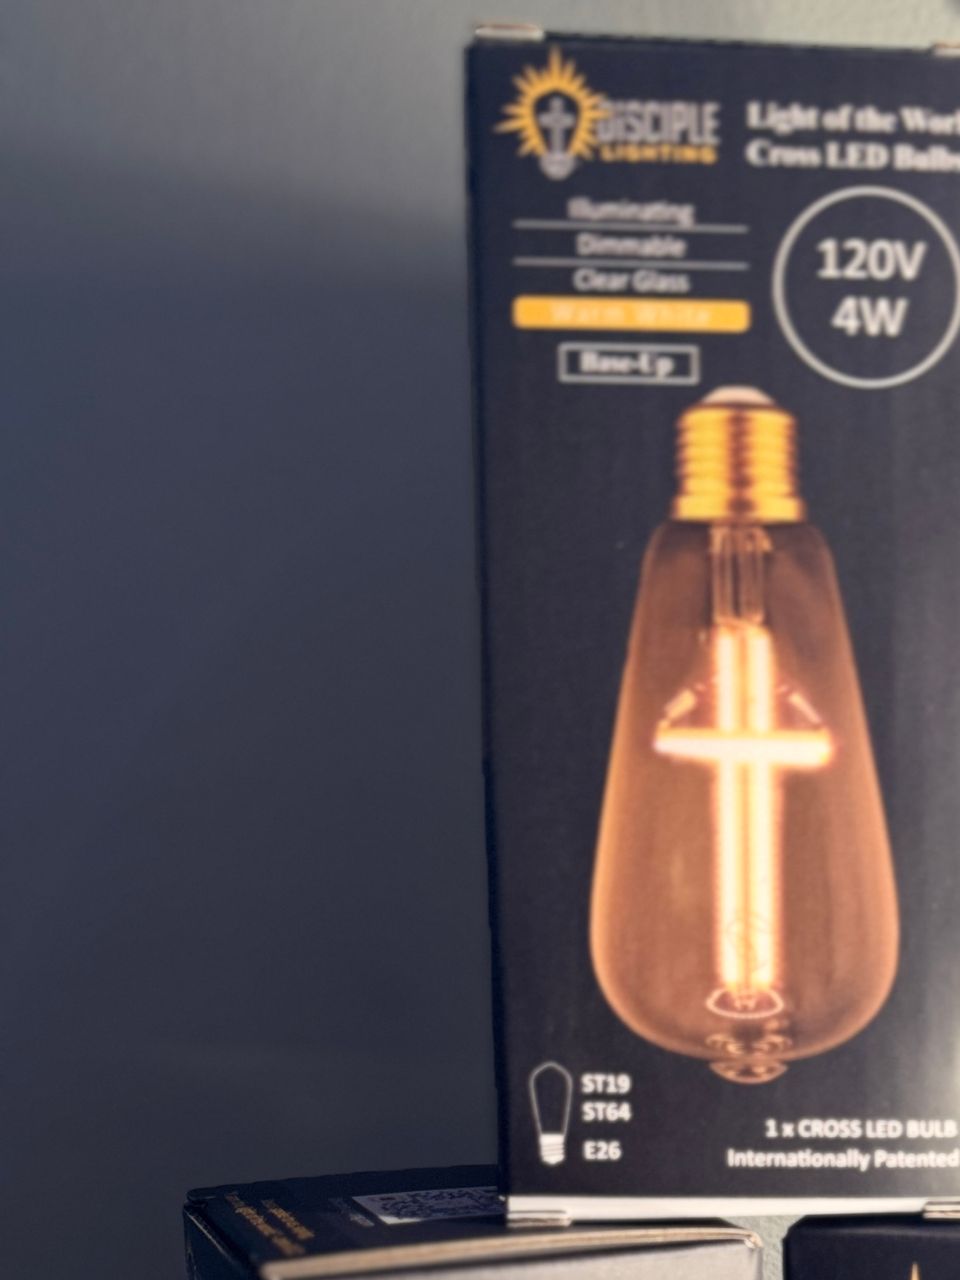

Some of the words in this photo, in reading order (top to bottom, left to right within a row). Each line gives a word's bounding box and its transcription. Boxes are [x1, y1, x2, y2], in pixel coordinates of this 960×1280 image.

[747, 100, 819, 135] Light
[822, 103, 852, 131] of
[855, 104, 897, 133] the
[601, 144, 717, 164] LIGHTING
[746, 138, 822, 167] Cross
[826, 141, 889, 168] LED
[567, 197, 695, 228] Illuminating
[576, 232, 688, 257] Dimmable
[815, 238, 926, 281] 120V
[573, 267, 628, 291] Clear
[632, 269, 690, 293] Glass
[552, 303, 624, 323] Warm
[636, 305, 711, 326] White
[831, 297, 909, 336] 4W
[579, 351, 675, 379] Base-Up
[582, 1074, 630, 1094] ST19
[582, 1102, 631, 1122] ST64
[765, 1119, 779, 1138] 1
[781, 1123, 795, 1138] x
[797, 1119, 862, 1139] CROSS
[866, 1120, 902, 1139] LED
[906, 1120, 958, 1139] BULB
[583, 1141, 622, 1160] E26
[726, 1148, 870, 1172] Internationally
[874, 1148, 960, 1169] Patented
